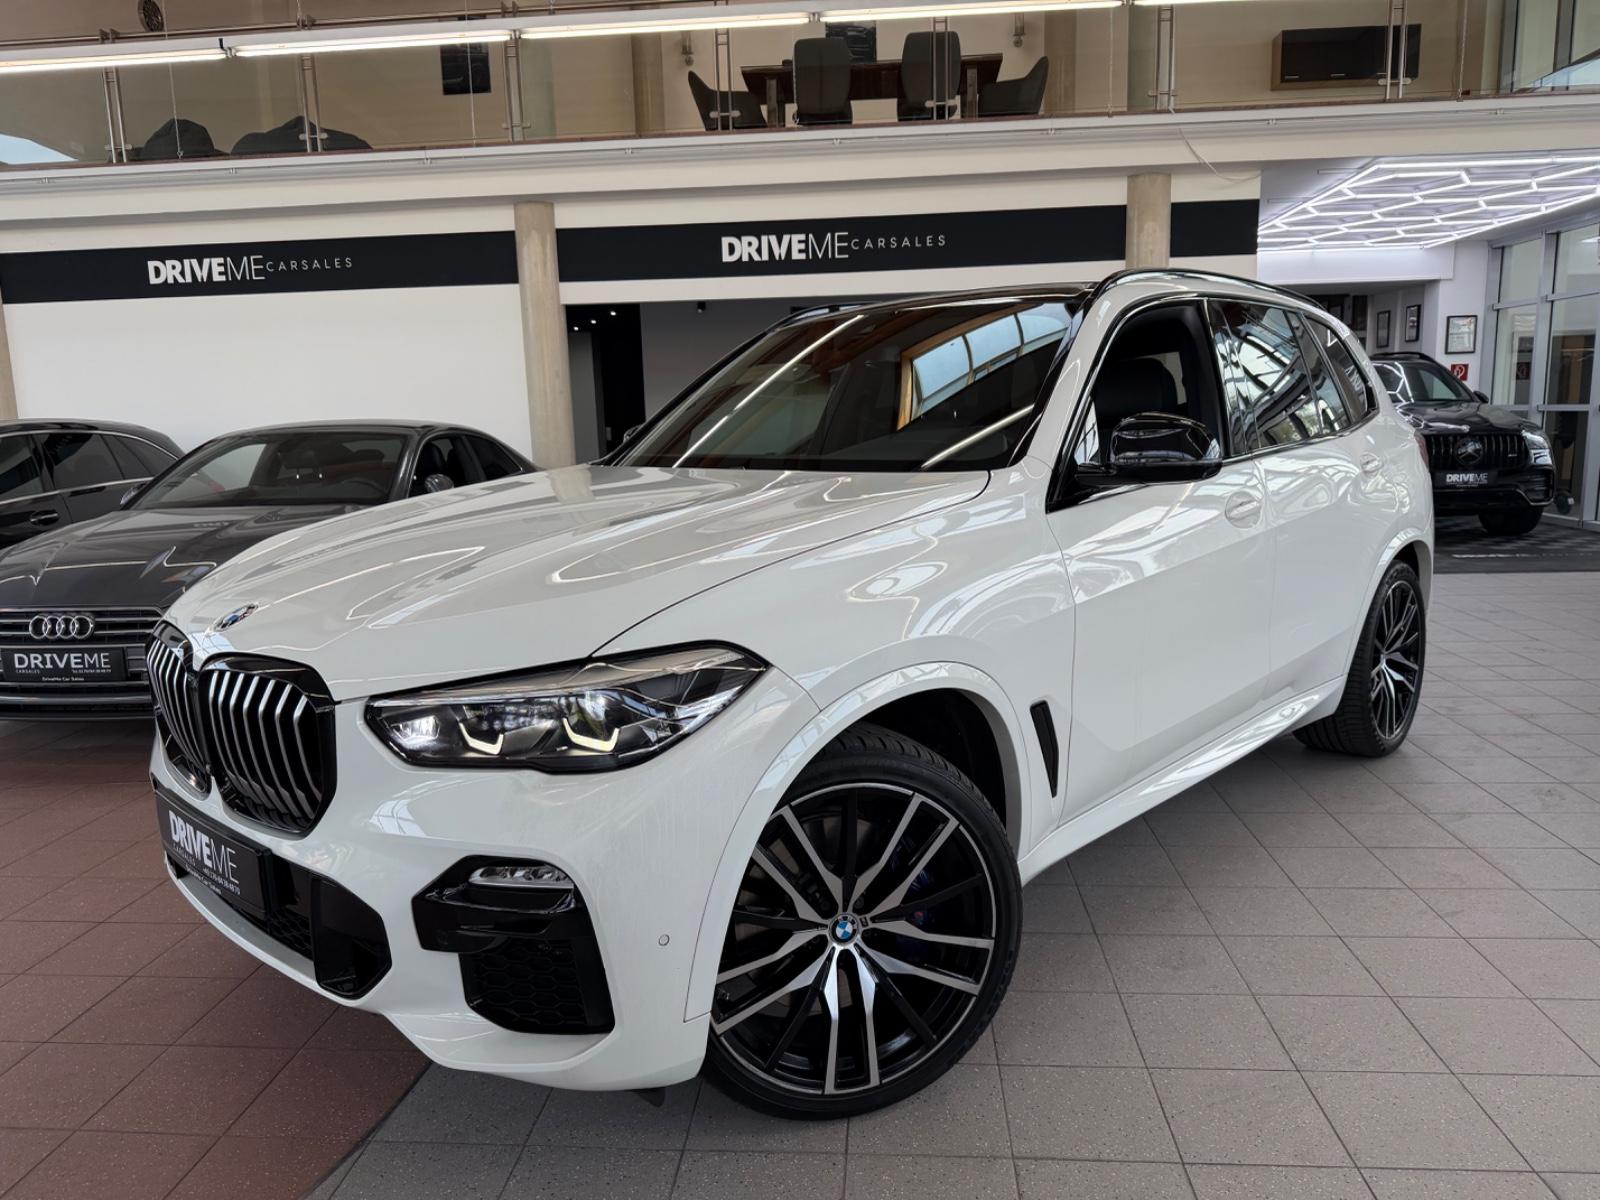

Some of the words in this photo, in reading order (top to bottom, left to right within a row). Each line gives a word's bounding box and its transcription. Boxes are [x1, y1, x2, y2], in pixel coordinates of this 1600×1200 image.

[850, 235, 946, 250] CARSALES
[266, 257, 353, 272] CARSALES
[13, 652, 111, 669] DRIVEME
[168, 809, 240, 885] DRIVEME
